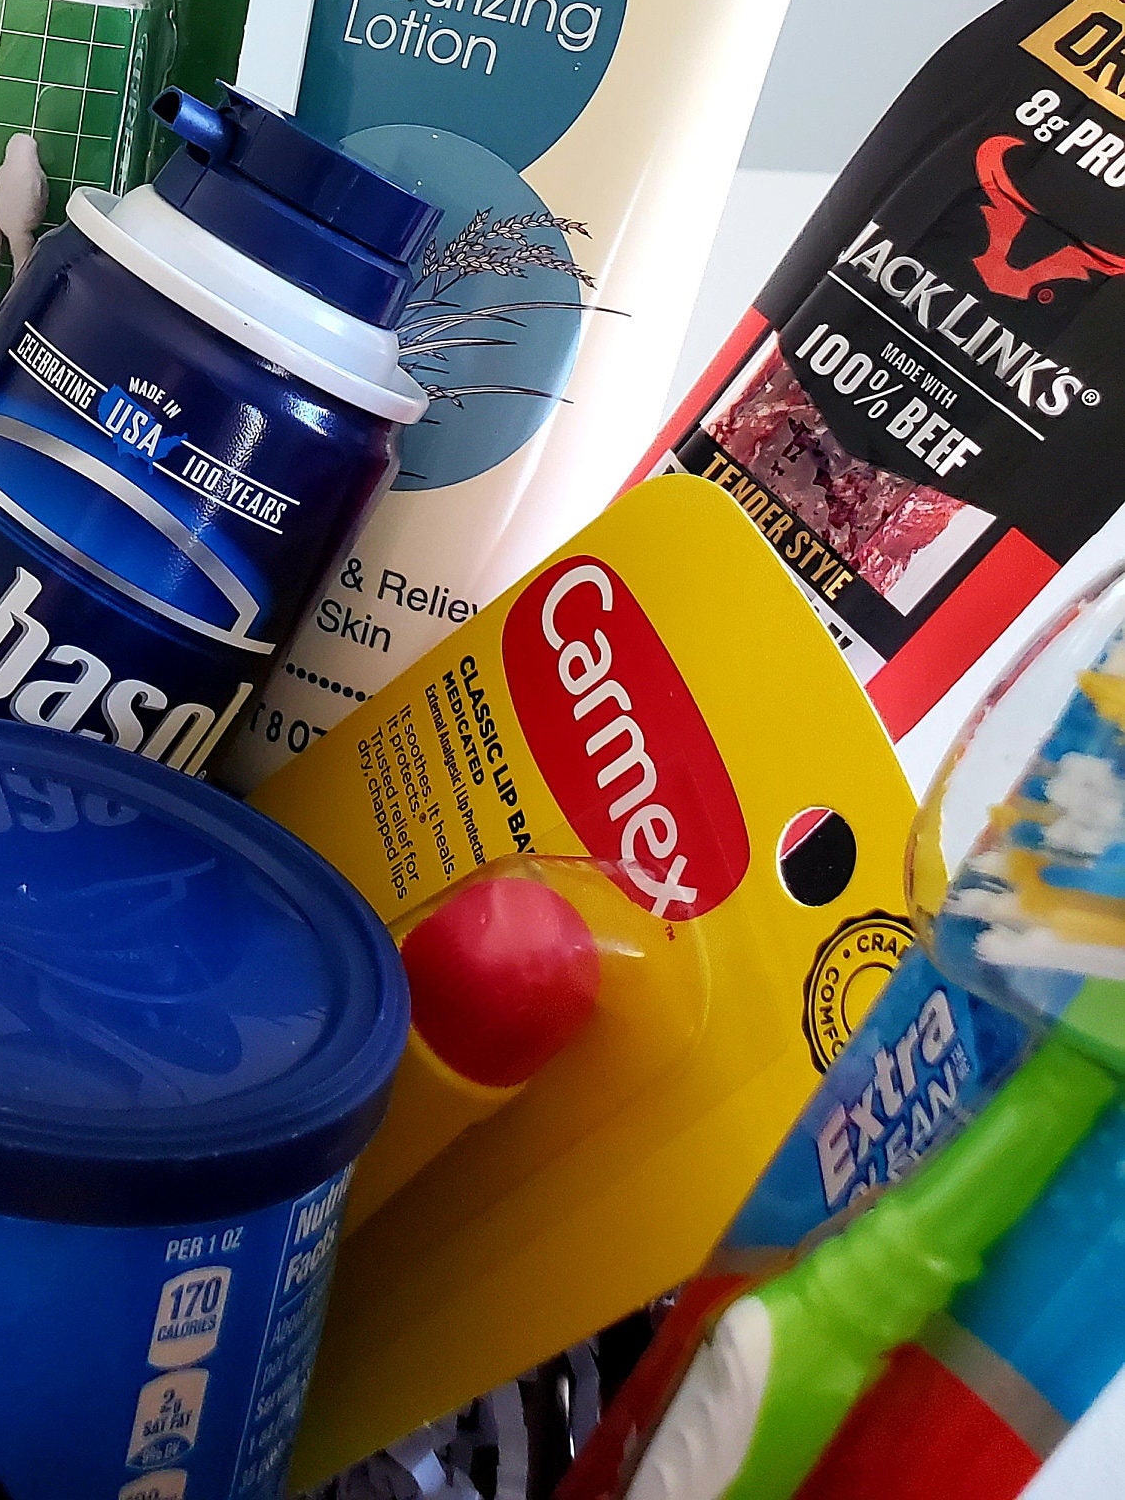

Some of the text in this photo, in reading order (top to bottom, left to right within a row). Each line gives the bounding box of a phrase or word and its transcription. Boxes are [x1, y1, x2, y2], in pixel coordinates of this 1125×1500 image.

[1015, 89, 1070, 142] 8g
[837, 219, 1084, 416] JACK LINK'S
[128, 376, 183, 419] MADE IN
[793, 322, 982, 477] 100% BEEF
[880, 341, 959, 410] MADE WITH
[17, 333, 288, 525] CELEBRATING USA 100 YEARS
[700, 451, 795, 546] TENDER
[317, 599, 392, 653] Skin
[340, 557, 364, 592] &
[386, 714, 399, 734] It
[425, 683, 446, 733] External
[437, 726, 463, 788] Analgesic
[442, 670, 485, 786] MEDICATED
[460, 655, 503, 764] CLASSIC
[492, 763, 518, 807] LIP
[542, 564, 697, 918] Carmex
[357, 738, 408, 900] dry, chapped lips
[370, 726, 420, 882] Trusted relief for
[399, 703, 455, 881] It soothes. It heals.
[816, 988, 956, 1208] Extra
[164, 1236, 204, 1262] PER
[221, 1226, 244, 1252] OZ
[157, 1314, 217, 1342] CALORIES
[170, 1276, 222, 1320] 170
